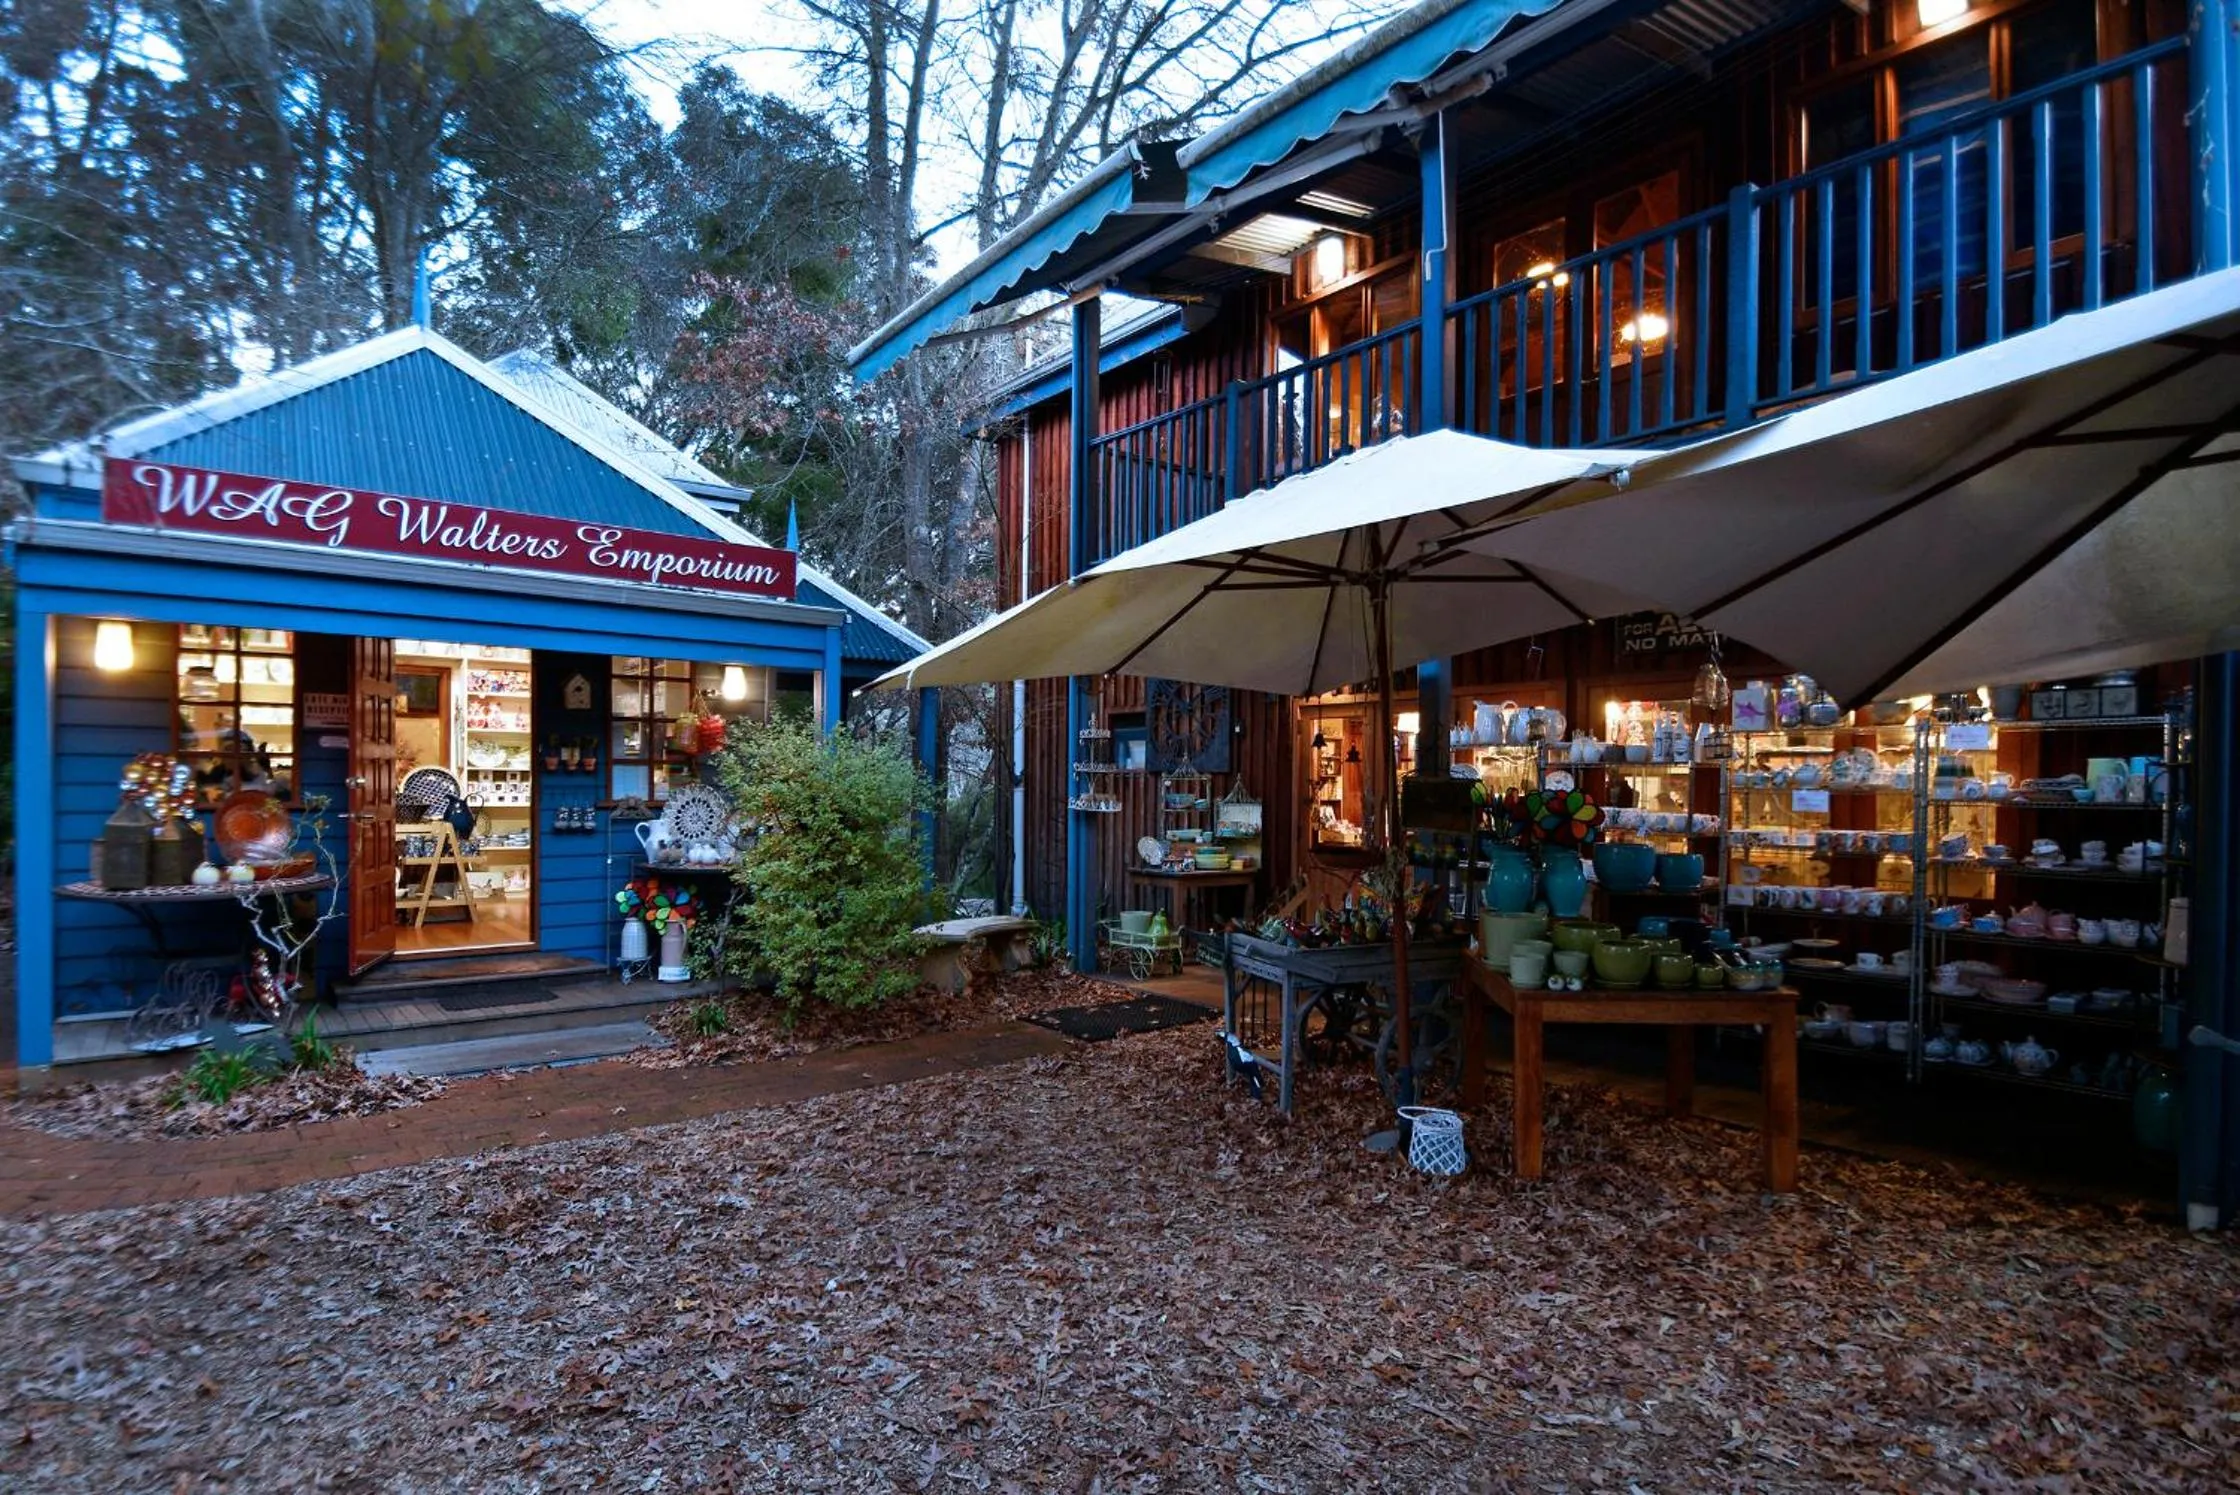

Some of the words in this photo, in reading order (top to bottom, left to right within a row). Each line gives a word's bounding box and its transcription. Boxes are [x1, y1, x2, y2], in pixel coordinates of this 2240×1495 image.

[133, 464, 353, 547] WAG
[378, 497, 568, 559] Walters
[577, 525, 780, 584] Emporium
[1624, 621, 1653, 636] FOR
[1625, 637, 1657, 652] NO
[1668, 632, 1715, 648] MAT
